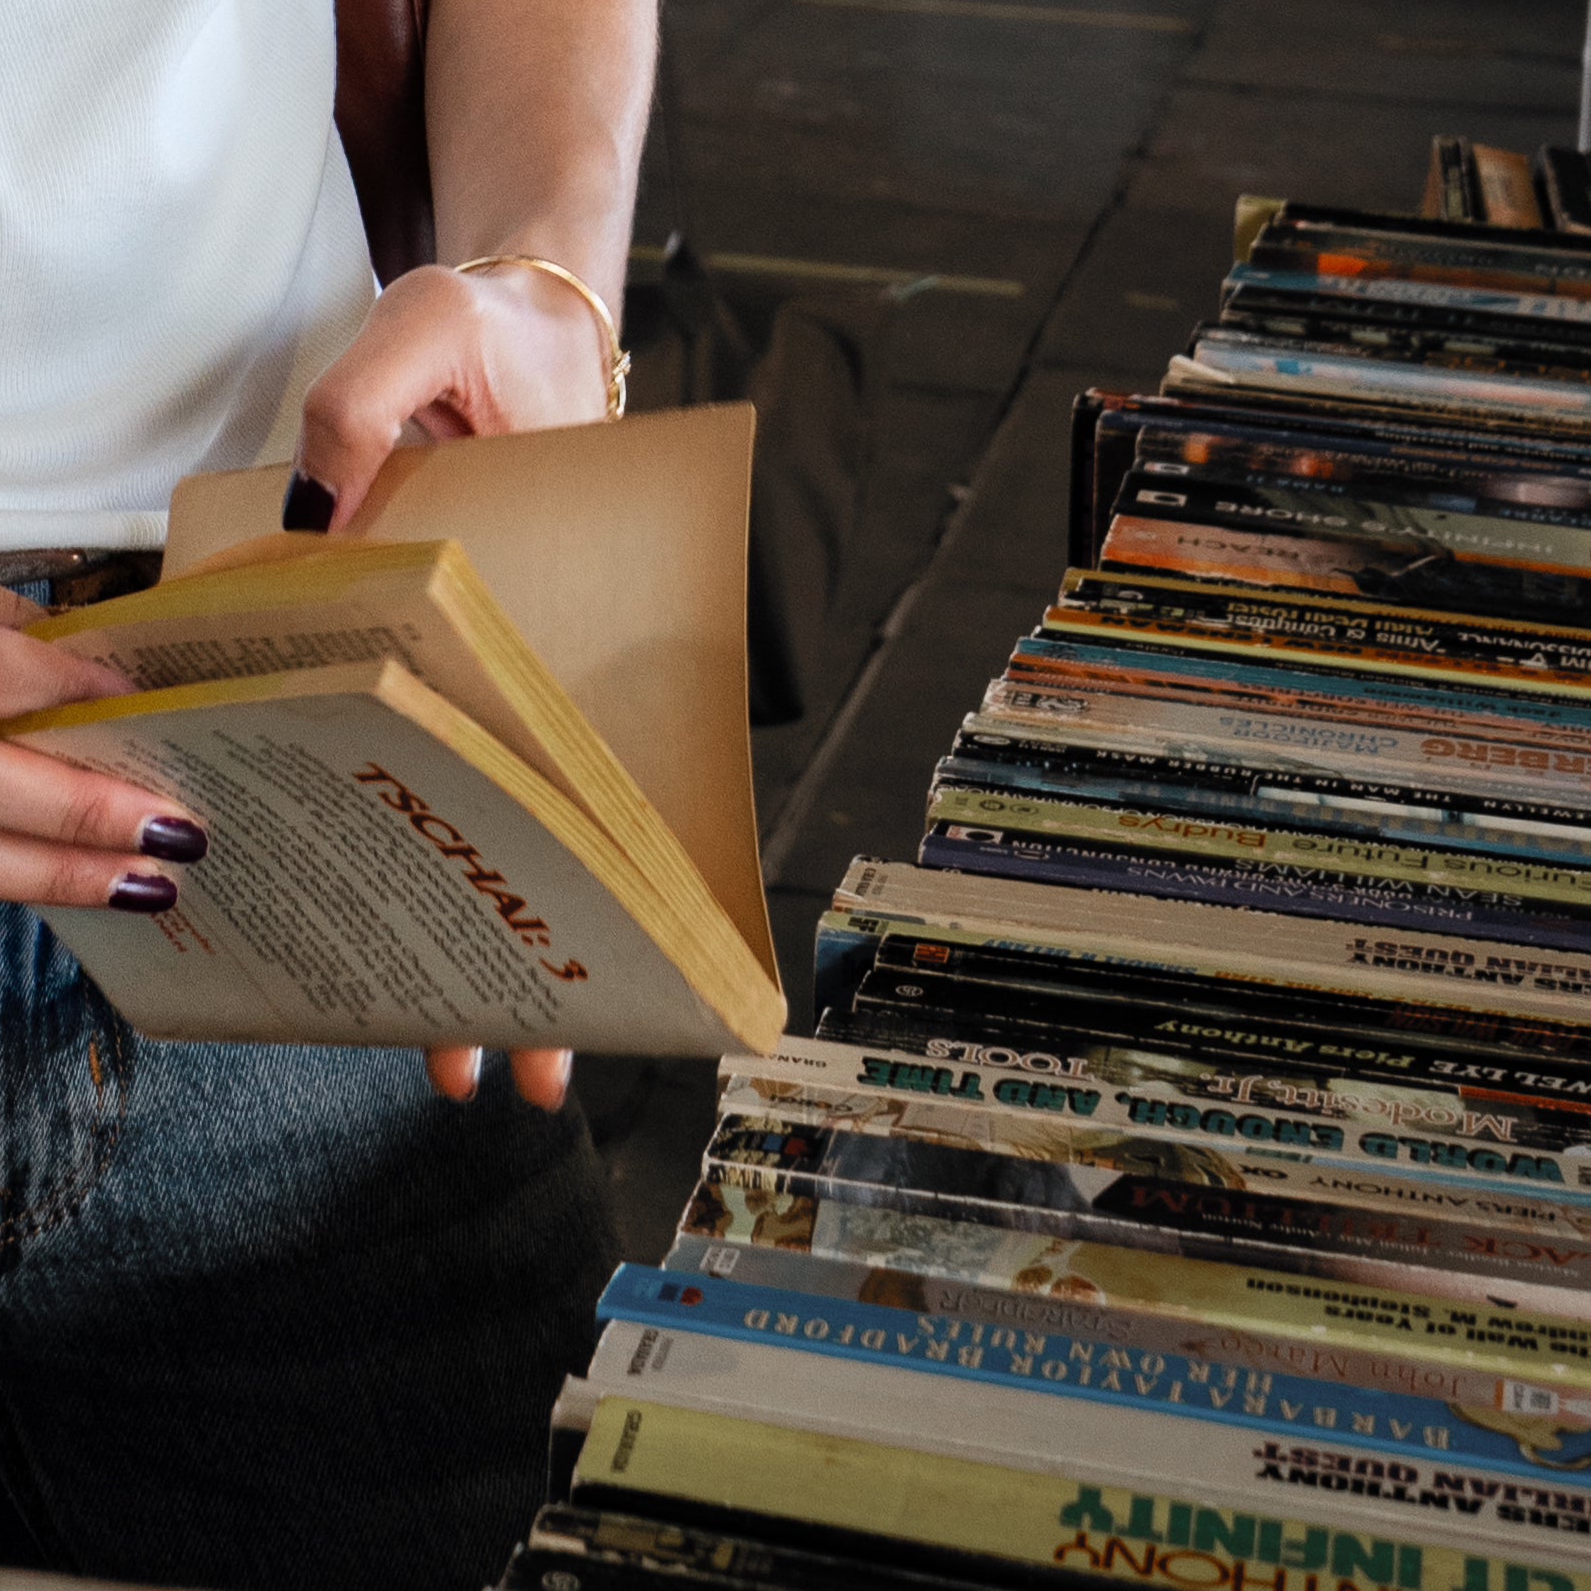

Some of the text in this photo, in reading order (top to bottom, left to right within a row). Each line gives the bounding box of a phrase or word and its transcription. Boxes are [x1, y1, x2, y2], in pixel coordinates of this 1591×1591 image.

[1214, 499, 1349, 528] SHORE
[1176, 535, 1298, 560] REACH
[1219, 715, 1397, 749] CHRONICLES
[1095, 748, 1156, 767] MASK
[1167, 757, 1251, 780] RUBBER
[1250, 769, 1301, 785] THE
[1314, 777, 1337, 789] IN
[1349, 781, 1400, 797] MAN
[1413, 789, 1450, 803] THE
[1118, 810, 1265, 849] Budrys
[351, 760, 590, 984] TSCHAI: 3
[1292, 836, 1427, 870] Future
[1125, 861, 1473, 925] PRISONERS AND PAWNS
[1233, 856, 1521, 908] SEAN WILLIAMS
[1345, 932, 1475, 971] QUEST
[1346, 946, 1524, 991] ANTHONY
[1152, 1015, 1315, 1057] Anthony
[1316, 1039, 1416, 1071] Piers
[925, 1031, 1093, 1083] TOOLS
[1427, 1055, 1507, 1084] LYE
[1199, 1064, 1263, 1106] Jr.
[857, 1053, 1564, 1189] WORLD ENOUGH, AND TIME
[1241, 1165, 1286, 1181] OX
[1309, 1172, 1467, 1210] ANTHONY
[1475, 1199, 1555, 1223] PIERS
[1462, 1231, 1591, 1274] ACK
[1245, 1274, 1430, 1319] Stephenson
[1323, 1303, 1411, 1330] Years
[1425, 1320, 1455, 1337] of
[1443, 1308, 1475, 1325] M.
[742, 1303, 982, 1370] BRADFORD
[915, 1311, 1272, 1396] HER OWN RULES
[1218, 1333, 1348, 1379] Marco
[1465, 1326, 1538, 1351] Wall
[1007, 1349, 1184, 1405] TAYLOR
[1369, 1359, 1466, 1399] John
[1207, 1383, 1449, 1451] BARBARA
[1252, 1437, 1418, 1486] QUEST
[1255, 1459, 1481, 1517] ANTHONY
[1059, 1487, 1421, 1591] INFINITY
